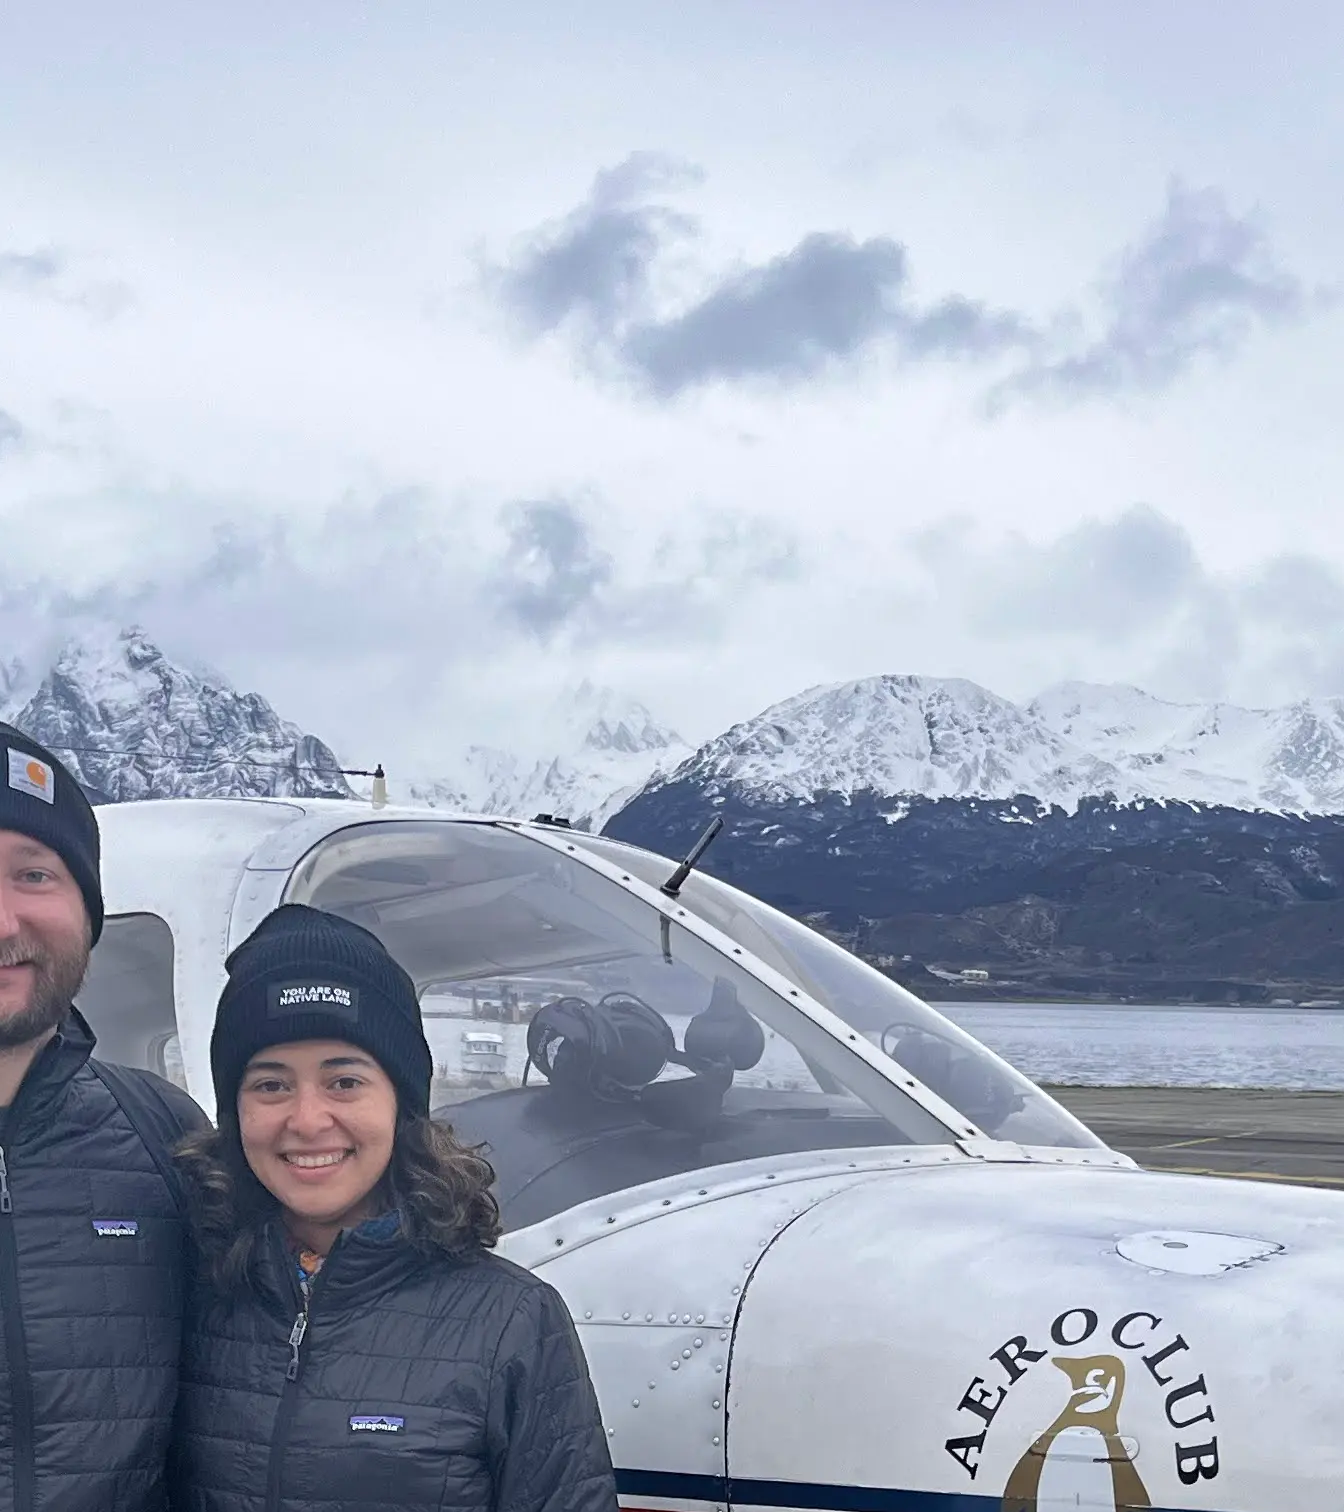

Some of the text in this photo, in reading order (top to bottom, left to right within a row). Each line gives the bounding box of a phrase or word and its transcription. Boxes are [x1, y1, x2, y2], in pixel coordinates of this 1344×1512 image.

[282, 986, 351, 999] YOU ARE ON
[279, 993, 351, 1006] NATIVE LAND
[97, 1227, 136, 1237] patagonia
[944, 1307, 1220, 1486] AEROCLUB
[351, 1422, 399, 1432] patagonia
